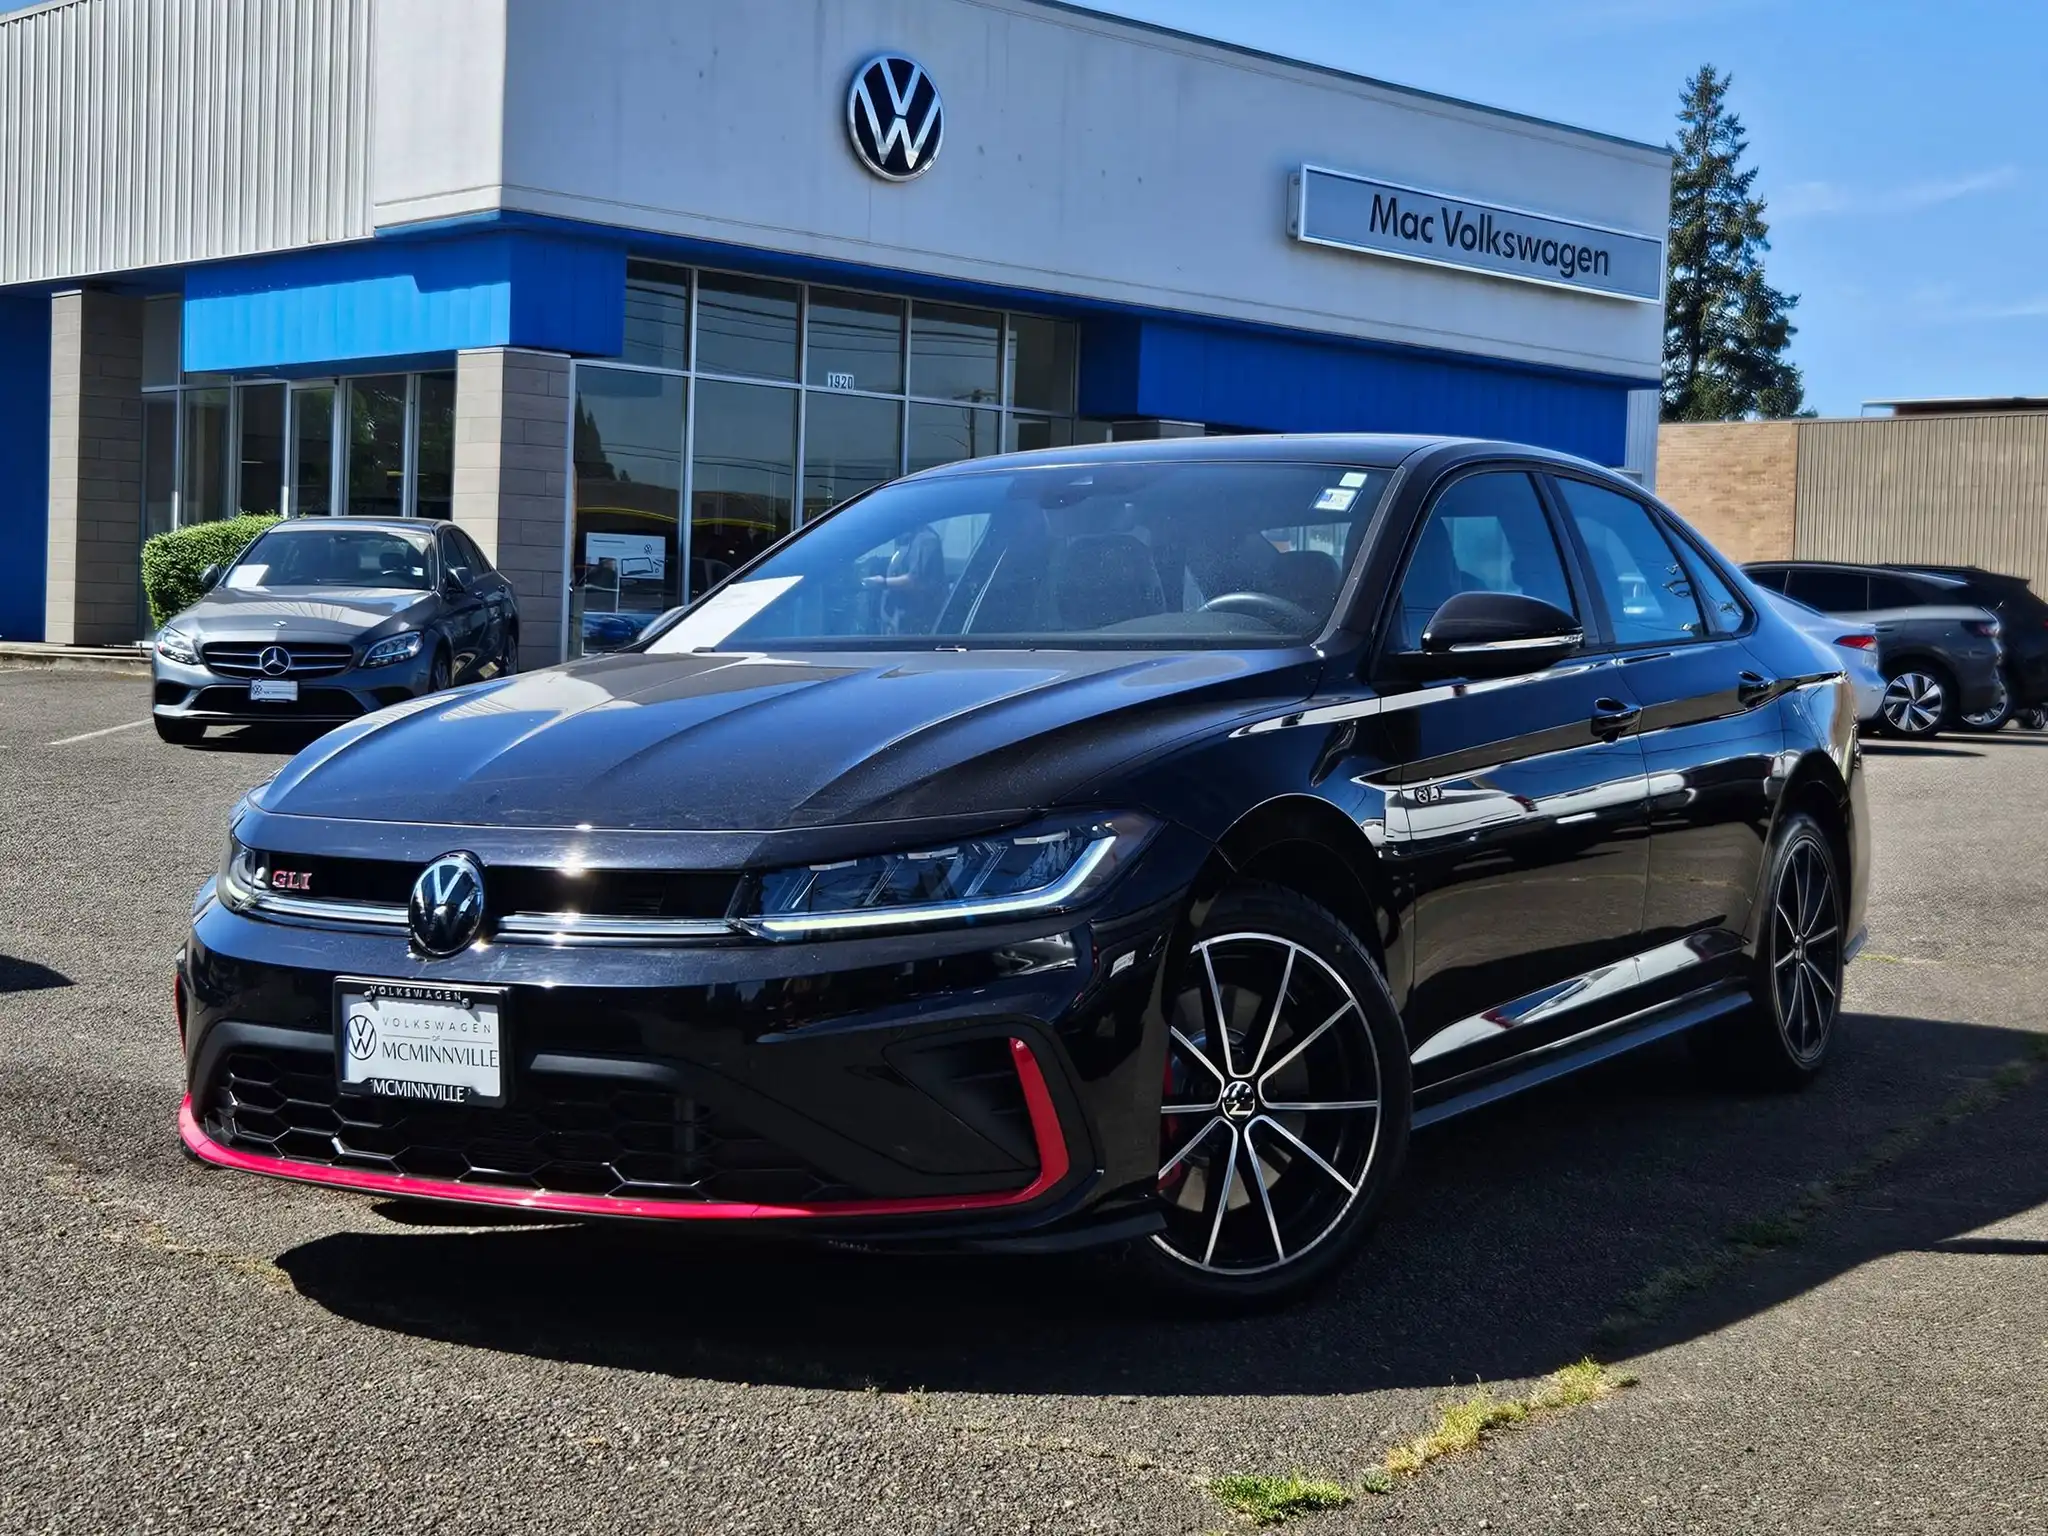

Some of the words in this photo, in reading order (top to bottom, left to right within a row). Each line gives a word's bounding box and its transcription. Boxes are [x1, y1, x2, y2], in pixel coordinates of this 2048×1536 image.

[1369, 193, 1434, 244] Mac
[1441, 207, 1609, 278] Volkswagen
[829, 374, 853, 389] 1920
[272, 870, 312, 890] GLI
[370, 985, 462, 1001] VOLKSWAGEN
[382, 1017, 492, 1034] VOLKSWAGEN
[382, 1041, 499, 1068] MCMINNVILLE
[373, 1079, 465, 1102] MCMINNVILLE
